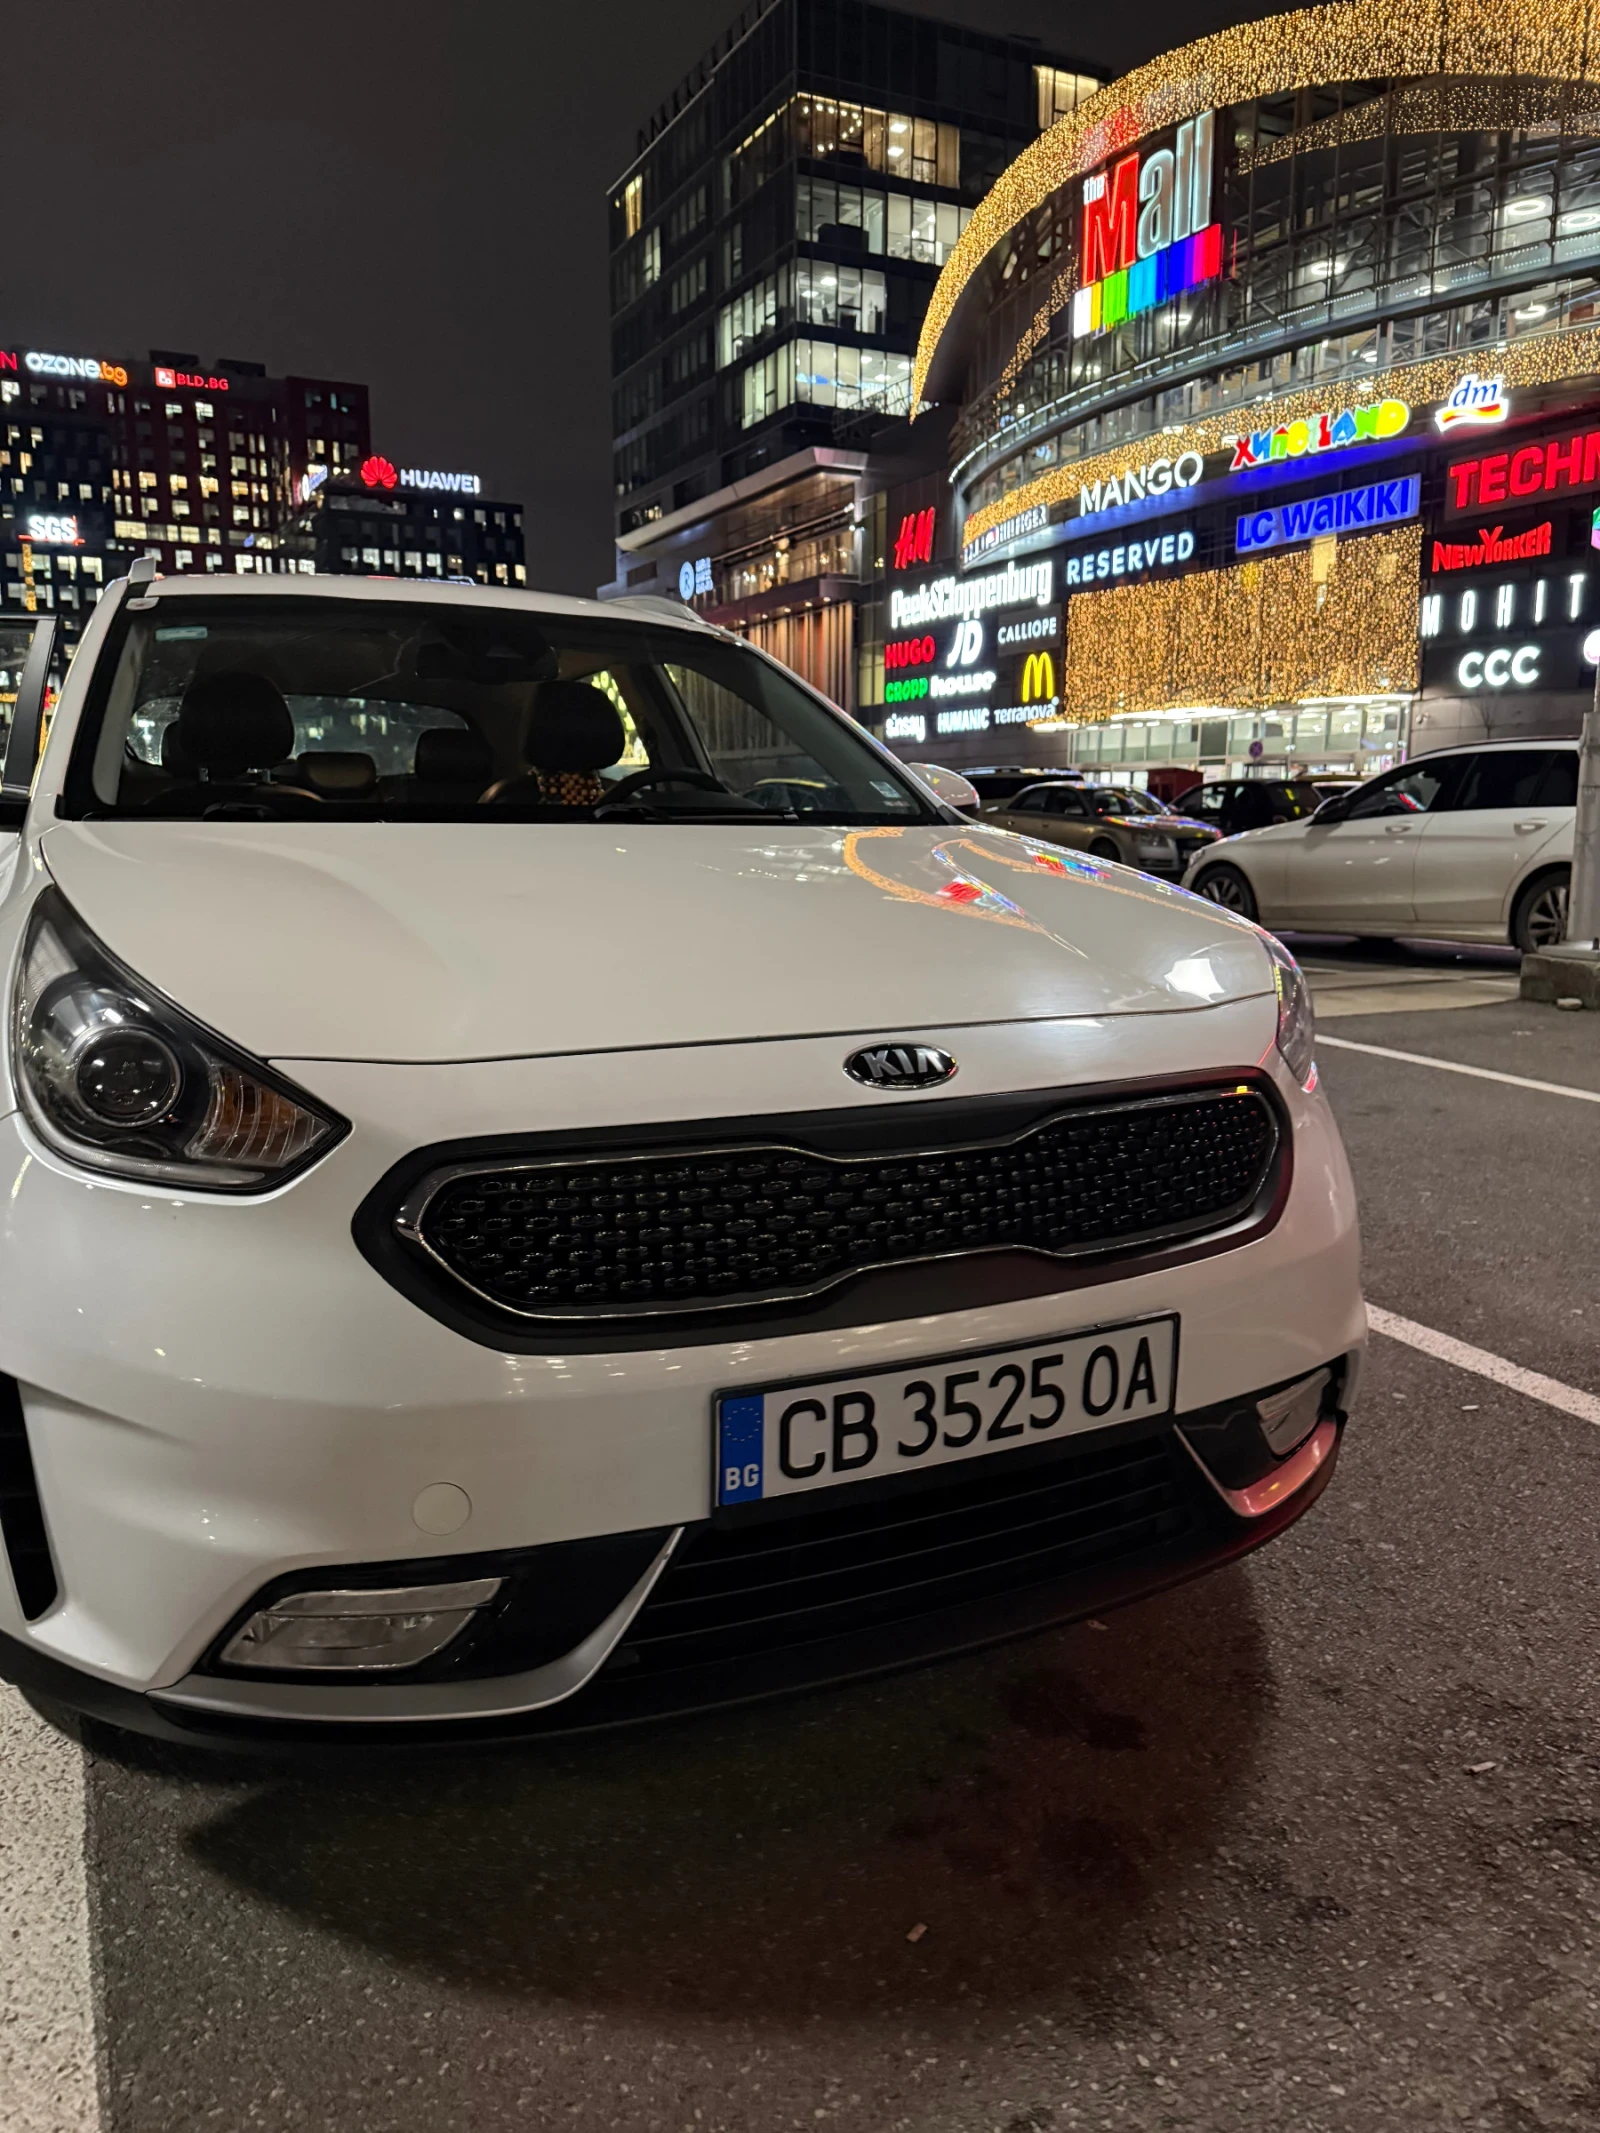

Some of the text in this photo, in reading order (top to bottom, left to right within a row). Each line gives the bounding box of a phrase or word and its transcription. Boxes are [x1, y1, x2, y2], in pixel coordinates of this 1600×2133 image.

[1082, 109, 1216, 288] the Mall
[177, 373, 229, 391] BLD.BG
[1453, 380, 1498, 407] dm
[400, 469, 480, 494] HUAWEI
[1080, 451, 1204, 517] MANGO
[29, 515, 78, 541] SGS
[1237, 511, 1274, 547] LC
[1066, 531, 1195, 585] RESERVED
[946, 620, 984, 668] JD
[997, 616, 1058, 644] CALLIOPE
[885, 635, 936, 669] HUGO
[1458, 646, 1541, 688] CCC
[885, 677, 929, 703] CROPP
[937, 708, 990, 733] HUMANIC
[861, 1048, 946, 1078] KIA
[779, 1336, 1158, 1480] CB 3525 OA
[725, 1463, 760, 1492] BG
